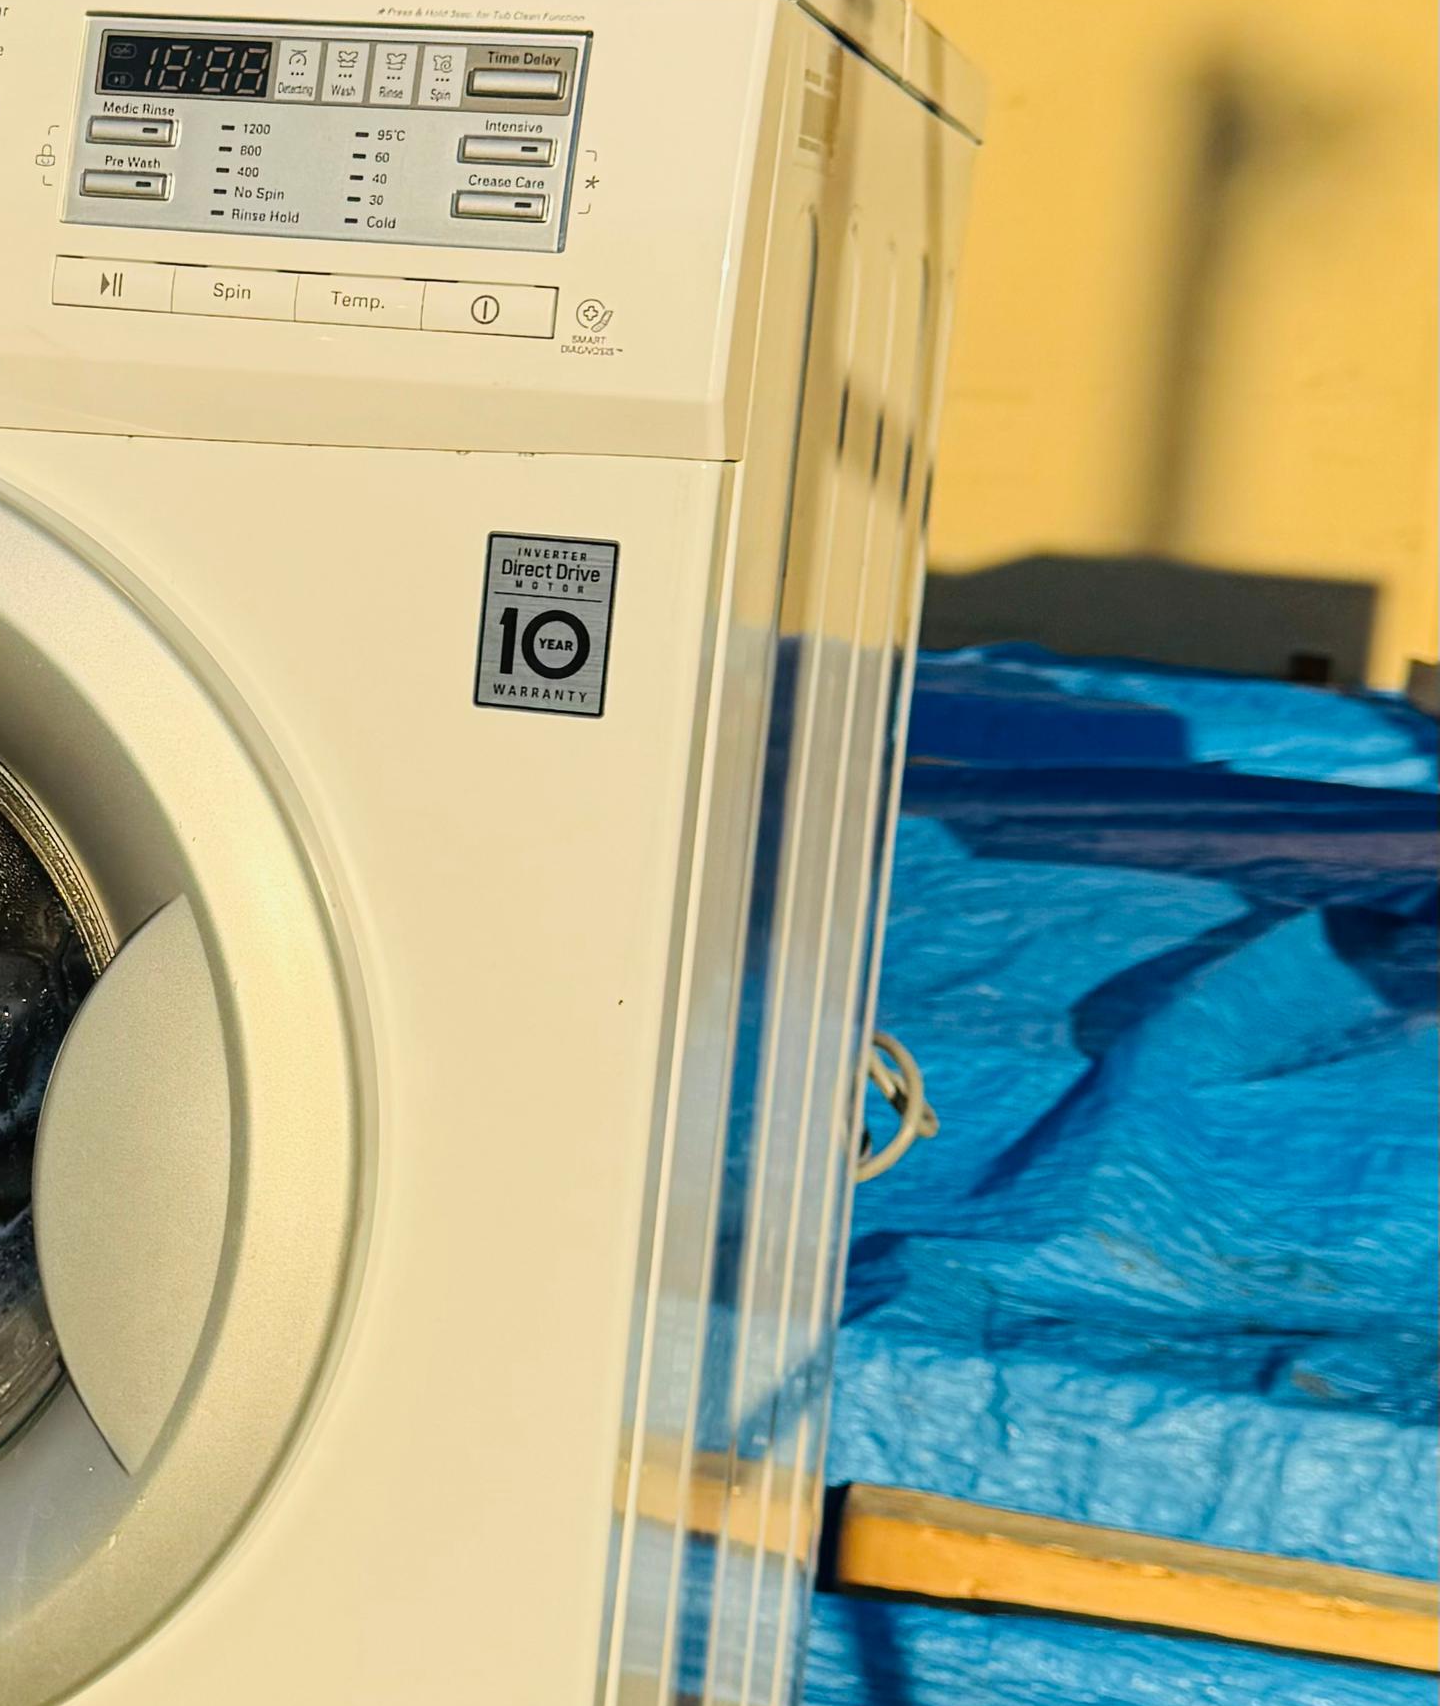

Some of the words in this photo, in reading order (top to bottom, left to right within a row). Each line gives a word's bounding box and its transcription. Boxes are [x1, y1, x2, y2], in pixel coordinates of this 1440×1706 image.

[489, 52, 520, 65] Time
[523, 53, 561, 68] Delay
[103, 101, 139, 115] Medic
[142, 103, 175, 117] Rinse
[243, 123, 271, 135] 1200
[485, 120, 543, 134] Intensive
[240, 145, 262, 157] 800
[374, 152, 390, 164] 60
[105, 155, 124, 168] Pre
[128, 156, 161, 169] Wash
[237, 166, 259, 178] 400
[372, 173, 388, 185] 40
[468, 174, 512, 188] Crease
[515, 176, 545, 190] Care
[234, 186, 253, 199] No
[256, 188, 285, 202] Spin
[369, 194, 384, 206] 30
[232, 208, 266, 222] Rinse
[270, 210, 300, 224] Hold
[366, 216, 397, 230] Cold
[213, 282, 252, 302] Spin
[330, 290, 385, 311] Temp.
[571, 335, 607, 344] SMART
[517, 547, 588, 562] INVERTER
[501, 558, 552, 579] Direct
[556, 563, 601, 583] Drive
[515, 580, 585, 594] MOTOR
[499, 607, 591, 680] 10
[539, 638, 574, 652] YEAR
[492, 683, 588, 703] WARRANTY
